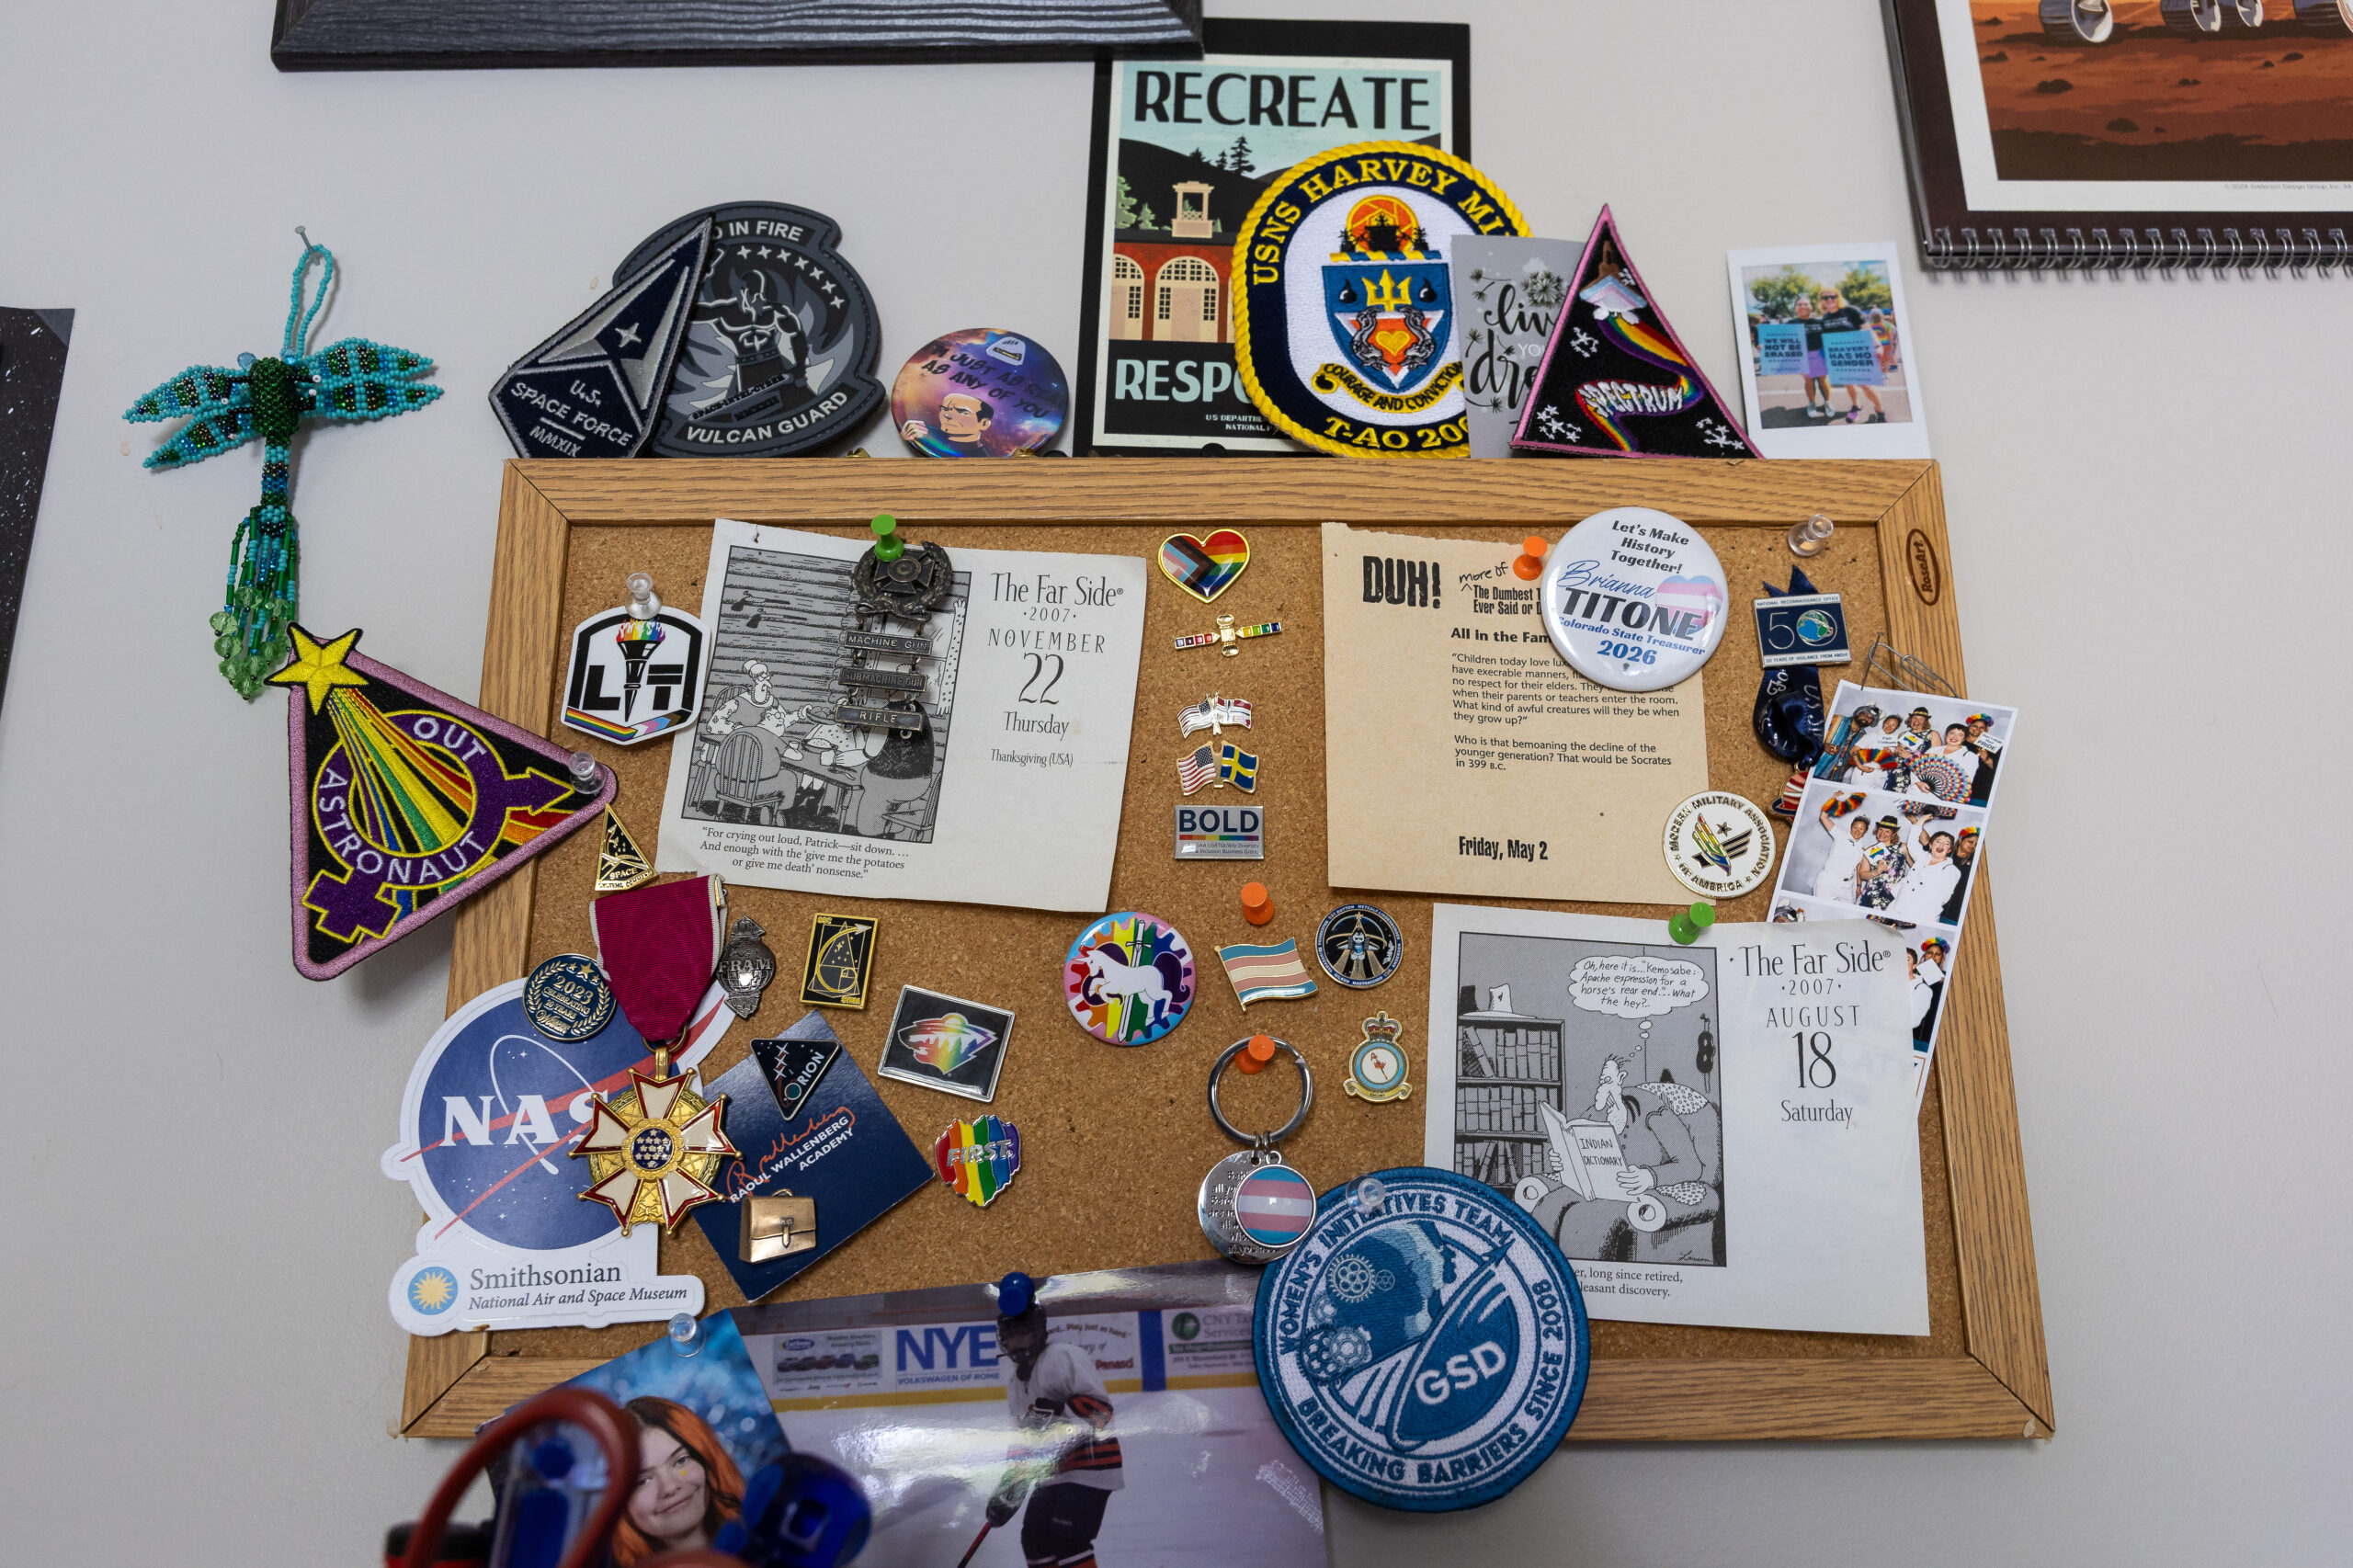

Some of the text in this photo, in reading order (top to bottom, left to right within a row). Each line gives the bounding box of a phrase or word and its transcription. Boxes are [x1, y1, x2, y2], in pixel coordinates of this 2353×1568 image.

[1134, 70, 1431, 131] RECREATE
[729, 221, 749, 236] IN
[756, 221, 803, 242] FIRE
[1253, 158, 1510, 285] USNS HARVEY MI
[950, 353, 994, 375] JUST
[569, 380, 602, 407] U.S.
[921, 359, 1050, 418] AS ANY OF YOU
[1324, 361, 1462, 410] COURAGE AND CONVICTION
[1578, 381, 1683, 417] SPECTRUM
[510, 382, 633, 447] SPACE FORCE
[687, 426, 772, 444] VULCAN
[778, 391, 848, 435] GUARD
[529, 426, 582, 457] MMXIX
[1324, 416, 1409, 449] T-AO
[1620, 537, 1676, 559] History
[1649, 528, 1689, 545] Make
[1610, 550, 1682, 574] Together!
[991, 572, 1029, 602] The
[1036, 574, 1068, 604] Far
[1362, 555, 1441, 609] DUH!
[1459, 570, 1492, 583] more
[1556, 560, 1654, 598] Brianna
[1473, 585, 1490, 599] The
[1493, 586, 1533, 601] Dumbest
[1473, 599, 1495, 614] Ever
[1498, 601, 1518, 615] Said
[1522, 605, 1533, 615] or
[1563, 587, 1703, 641] TITONE
[848, 635, 927, 651] MACHINE GUN
[988, 629, 1105, 653] NOVEMBER
[1450, 628, 1518, 642] All in the
[1559, 617, 1705, 654] Colorado State Treasurer
[1597, 640, 1657, 665] 2026
[843, 672, 904, 685] SUBMACHINE
[1018, 653, 1064, 705] 22
[1476, 666, 1522, 677] execrable
[859, 711, 897, 723] RIFLE
[1453, 699, 1479, 710] What
[1004, 711, 1069, 741] Thursday
[414, 717, 488, 763] OUT
[1512, 739, 1567, 752] bemoaning
[990, 749, 1074, 768] Thanksgiving (USA)
[1455, 747, 1672, 766] younger generation? would Socrates
[318, 767, 485, 883] ASTRONAUT
[1179, 810, 1259, 833] BOLD
[726, 832, 756, 843] crying
[758, 833, 776, 842] out
[778, 835, 802, 846] loud,
[1459, 835, 1548, 862] Friday, May 2
[1669, 795, 1770, 878] MODERN MILITARY ASSOCIATION
[699, 840, 904, 869] And enough with the the potatoes
[745, 859, 765, 870] give
[609, 868, 639, 880] SPACE
[1691, 874, 1744, 892] AMERICA
[719, 959, 771, 972] FRAM
[1584, 960, 1618, 972] Oh, here
[1738, 944, 1783, 976] The
[1790, 943, 1827, 975] Far
[552, 975, 594, 1005] 2023
[1580, 971, 1657, 986] Apache expression
[543, 986, 590, 1015] CELEBRATING
[1672, 989, 1695, 998] What
[1766, 1005, 1860, 1028] AUGUST
[1791, 1031, 1836, 1088] 18
[442, 1088, 610, 1146] NAS
[1780, 1098, 1853, 1130] Saturday
[799, 1127, 854, 1171] ACADEMY
[1579, 1138, 1612, 1150] INDIAN
[730, 1173, 771, 1203] RAOUL
[770, 1116, 849, 1173] WALLENBERG
[1582, 1155, 1623, 1166] DICTIONARY
[1455, 1201, 1516, 1247] TEAM
[470, 1263, 621, 1290] Smithsonian
[1589, 1268, 1683, 1284] long since retired,
[468, 1287, 688, 1311] National Air and Space Museum
[1619, 1283, 1671, 1299] discovery.
[896, 1324, 1000, 1372] NYE
[1524, 1278, 1564, 1421] SINCE 2008
[897, 1373, 959, 1385] VOLKSWAGEN
[1415, 1341, 1507, 1406] GSD
[1296, 1396, 1528, 1484] BREAKING BARRIERS
